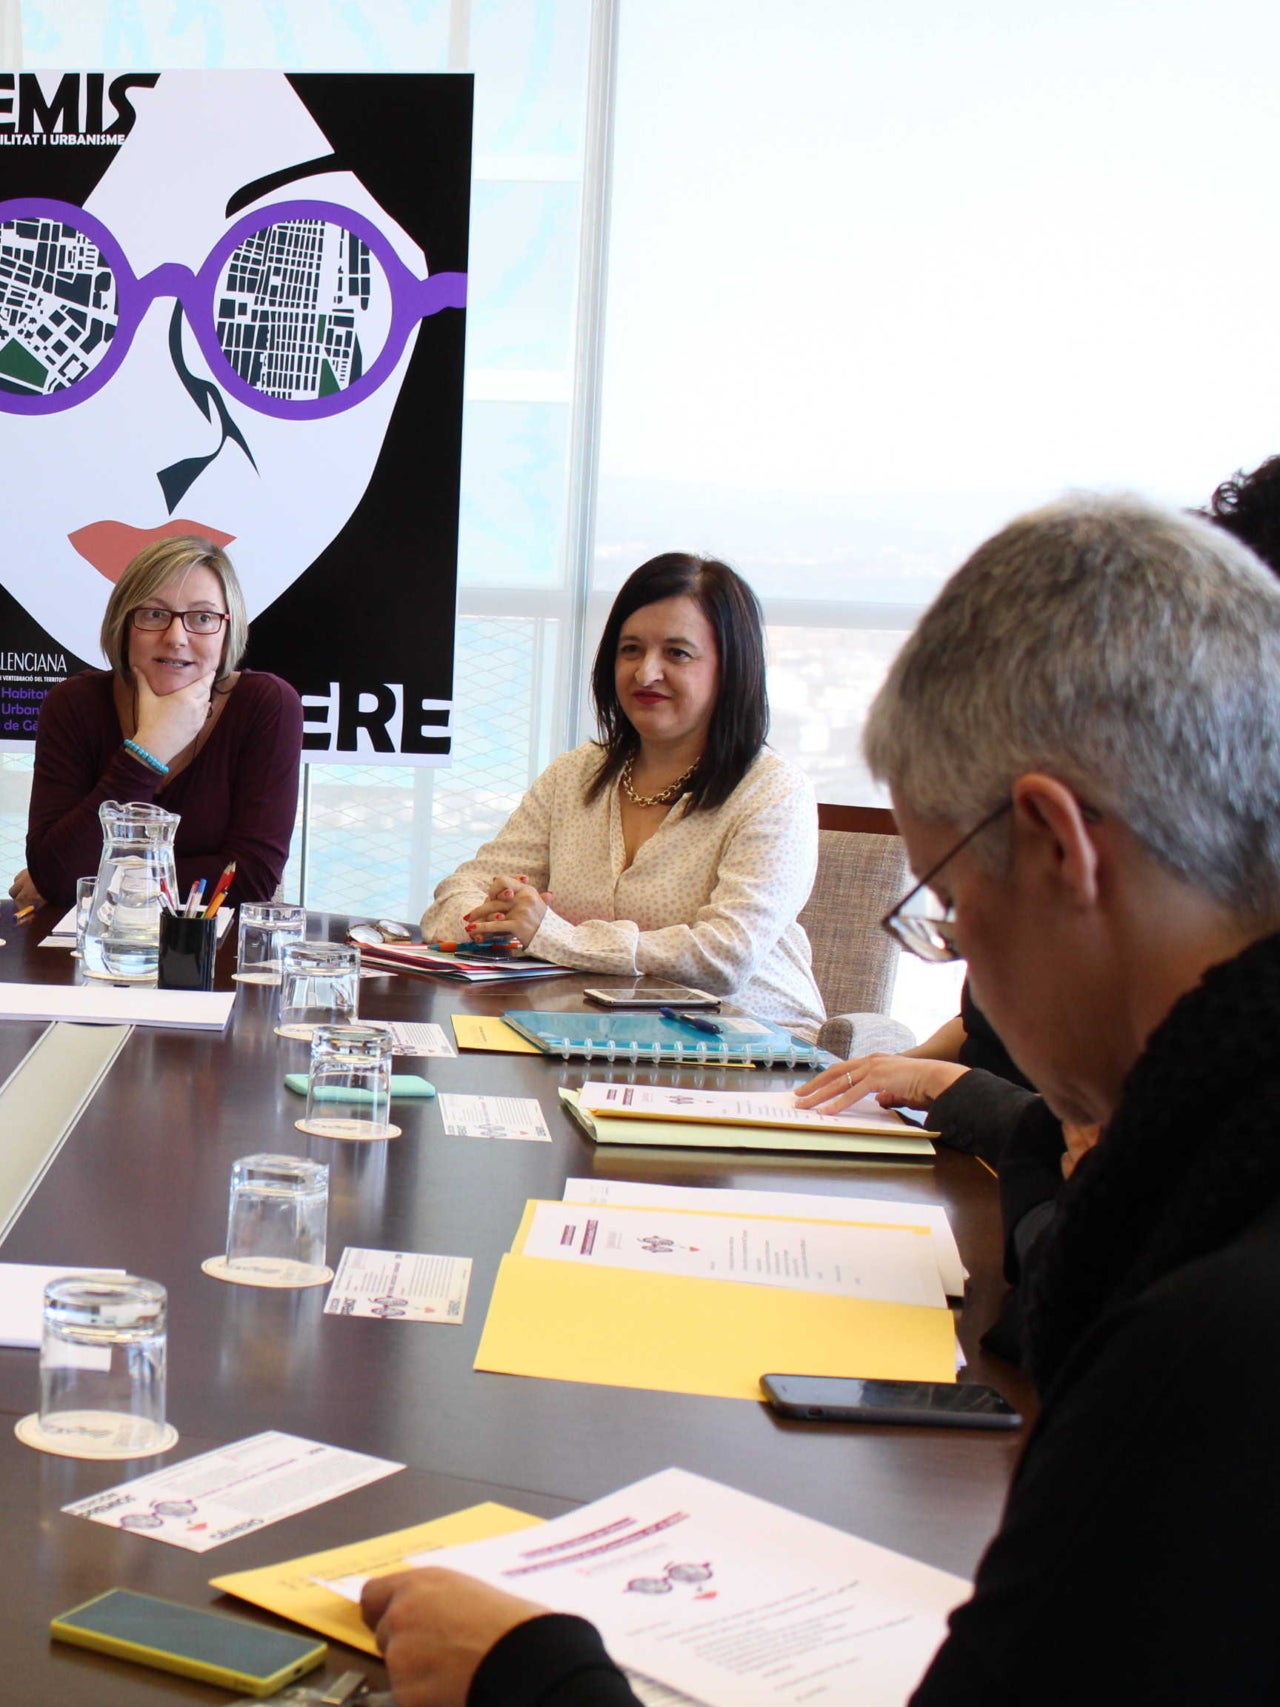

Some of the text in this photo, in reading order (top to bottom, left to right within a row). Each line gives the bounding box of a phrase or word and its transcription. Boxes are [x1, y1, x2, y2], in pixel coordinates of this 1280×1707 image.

[42, 134, 47, 146] I
[50, 134, 126, 146] URBANISME
[4, 718, 19, 731] de
